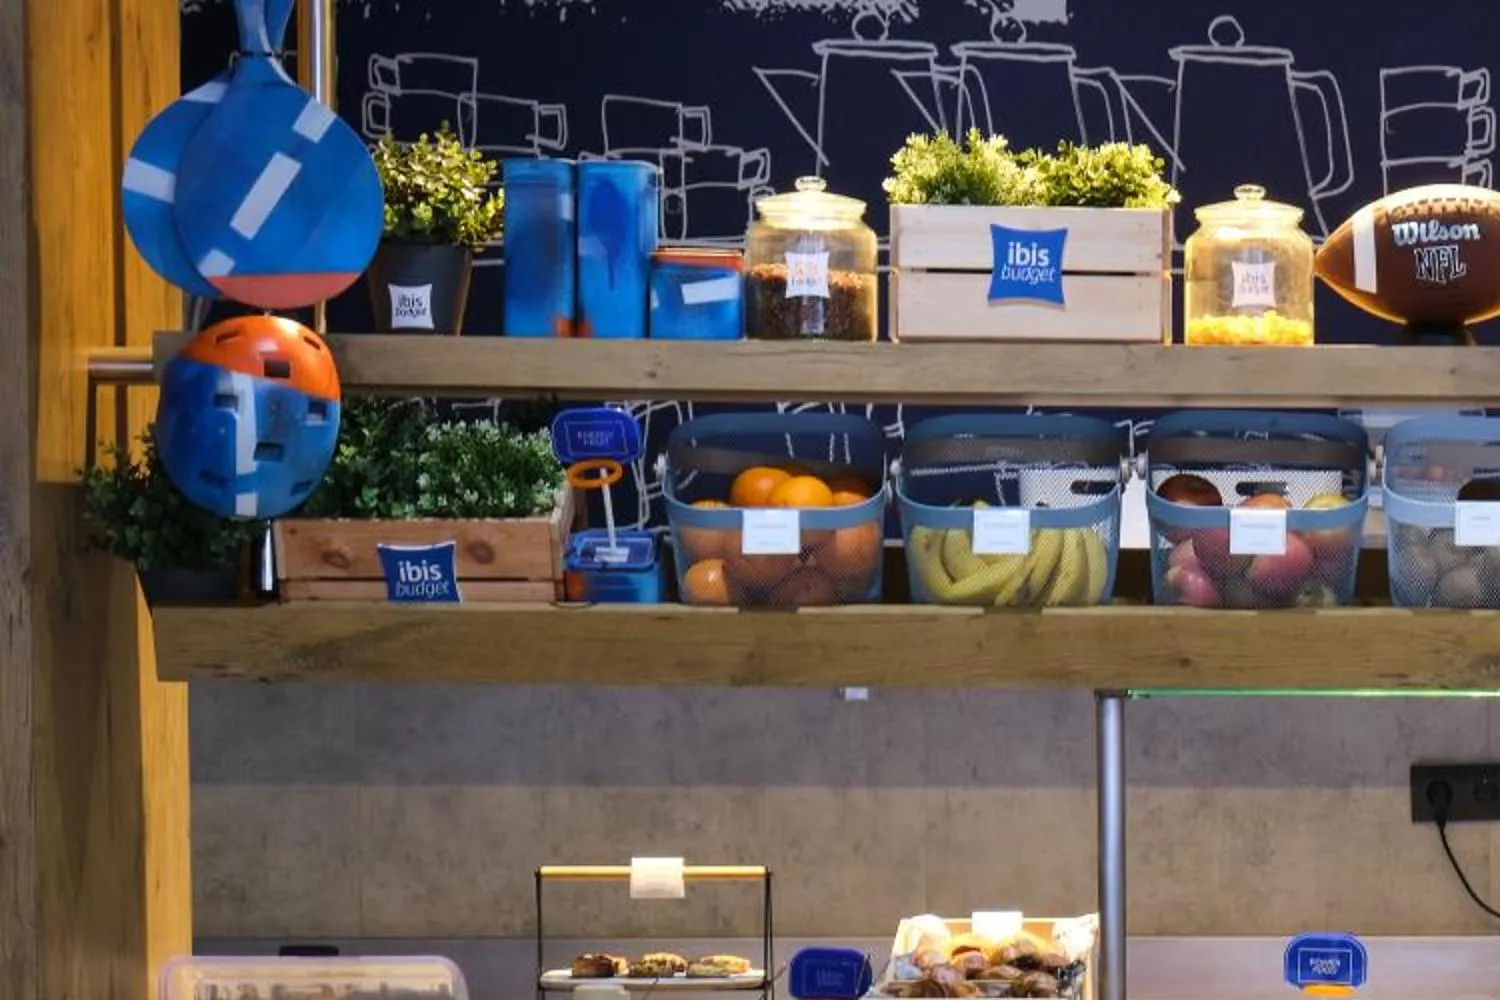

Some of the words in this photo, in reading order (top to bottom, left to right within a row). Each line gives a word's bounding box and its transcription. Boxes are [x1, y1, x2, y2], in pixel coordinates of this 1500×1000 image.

[1391, 219, 1481, 247] Wilson
[1007, 241, 1051, 267] ibis
[1413, 244, 1468, 286] NFL
[1000, 263, 1057, 287] budget
[397, 560, 443, 583] ibis
[395, 580, 450, 599] budget
